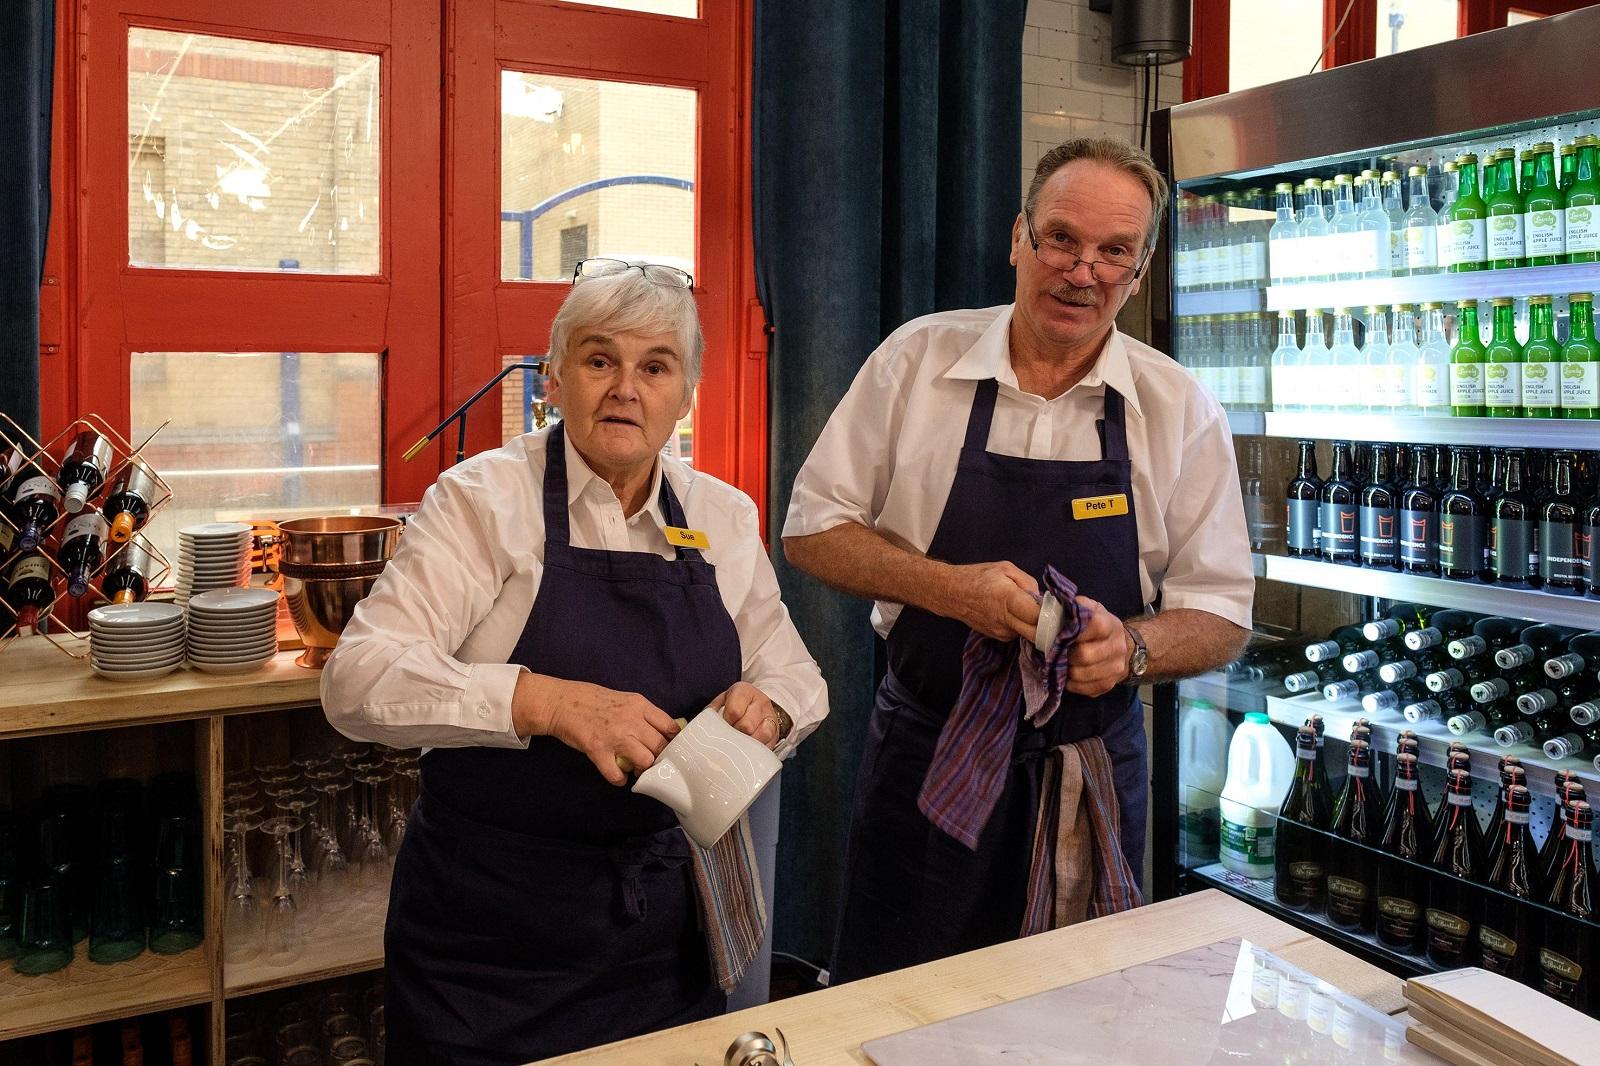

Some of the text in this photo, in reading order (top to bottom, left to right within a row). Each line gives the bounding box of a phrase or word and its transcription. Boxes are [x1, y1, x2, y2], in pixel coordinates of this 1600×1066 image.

[1086, 499, 1114, 511] Pete T
[679, 531, 695, 541] Sue
[1546, 555, 1583, 564] INDEPENDEN
